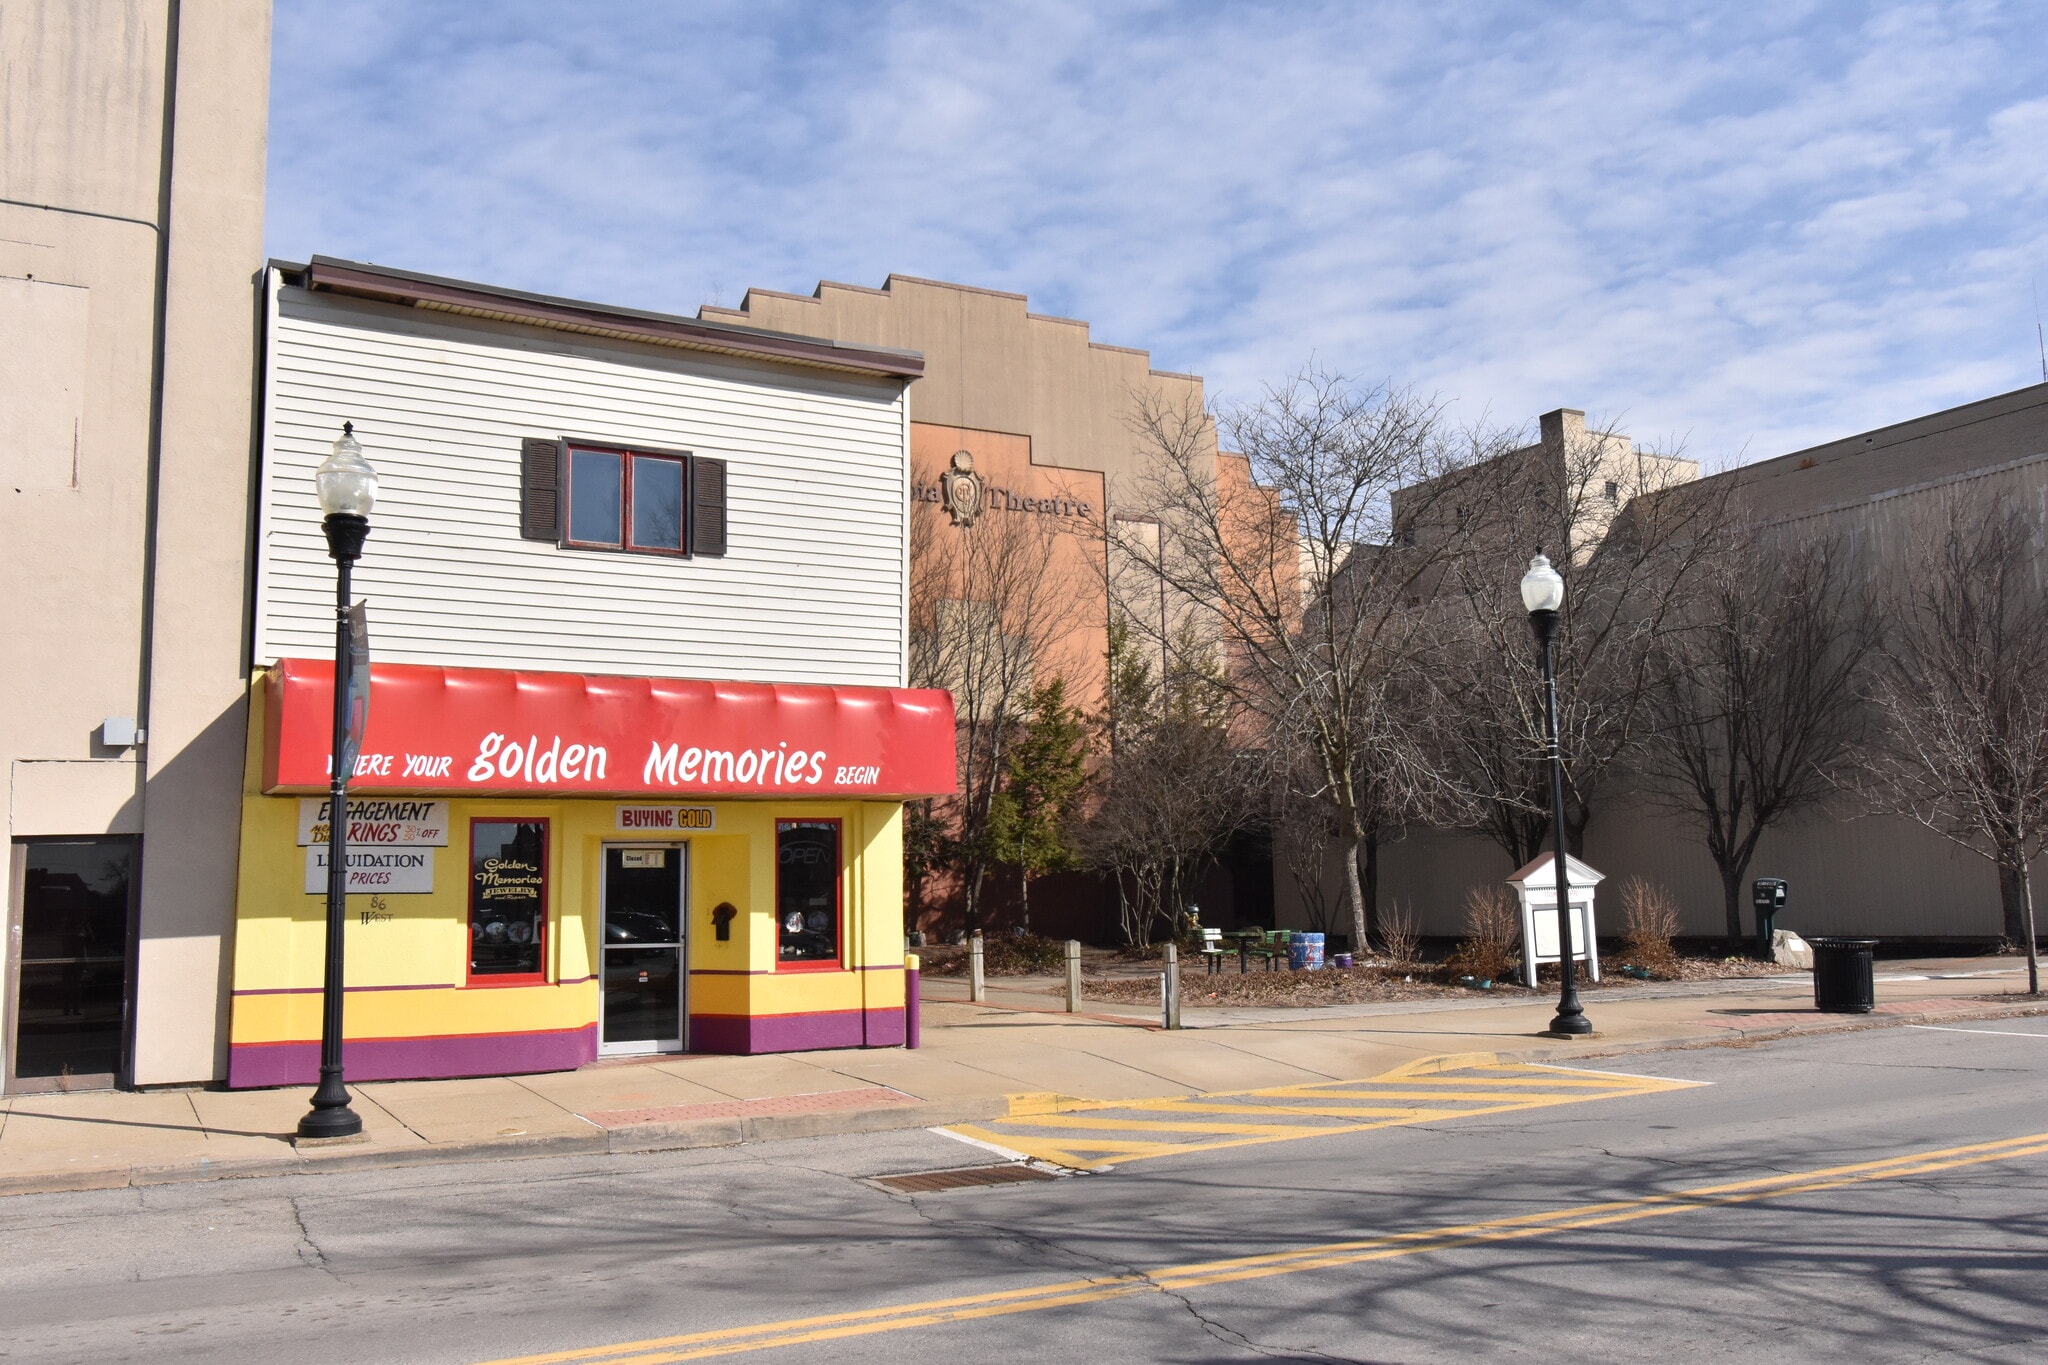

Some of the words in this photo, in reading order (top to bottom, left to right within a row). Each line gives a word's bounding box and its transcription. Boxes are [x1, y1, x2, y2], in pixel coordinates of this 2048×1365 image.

[985, 487, 1091, 517] Theatre
[326, 754, 394, 776] ERE
[402, 753, 452, 778] YOUR
[467, 731, 608, 784] golden
[643, 740, 827, 786] Memories
[834, 765, 880, 785] BEGIN
[318, 801, 435, 821] EGAGEMENT
[622, 809, 673, 827] BUYING
[678, 808, 712, 828] GOLD
[347, 822, 401, 842] RINGS
[421, 829, 440, 838] OFF
[317, 853, 424, 867] LUIDATION
[779, 847, 830, 864] OPEN
[484, 858, 537, 872] Golden
[350, 872, 391, 885] PRICES
[475, 872, 543, 886] Memories
[487, 887, 533, 895] JEWELRY
[370, 896, 387, 910] 86
